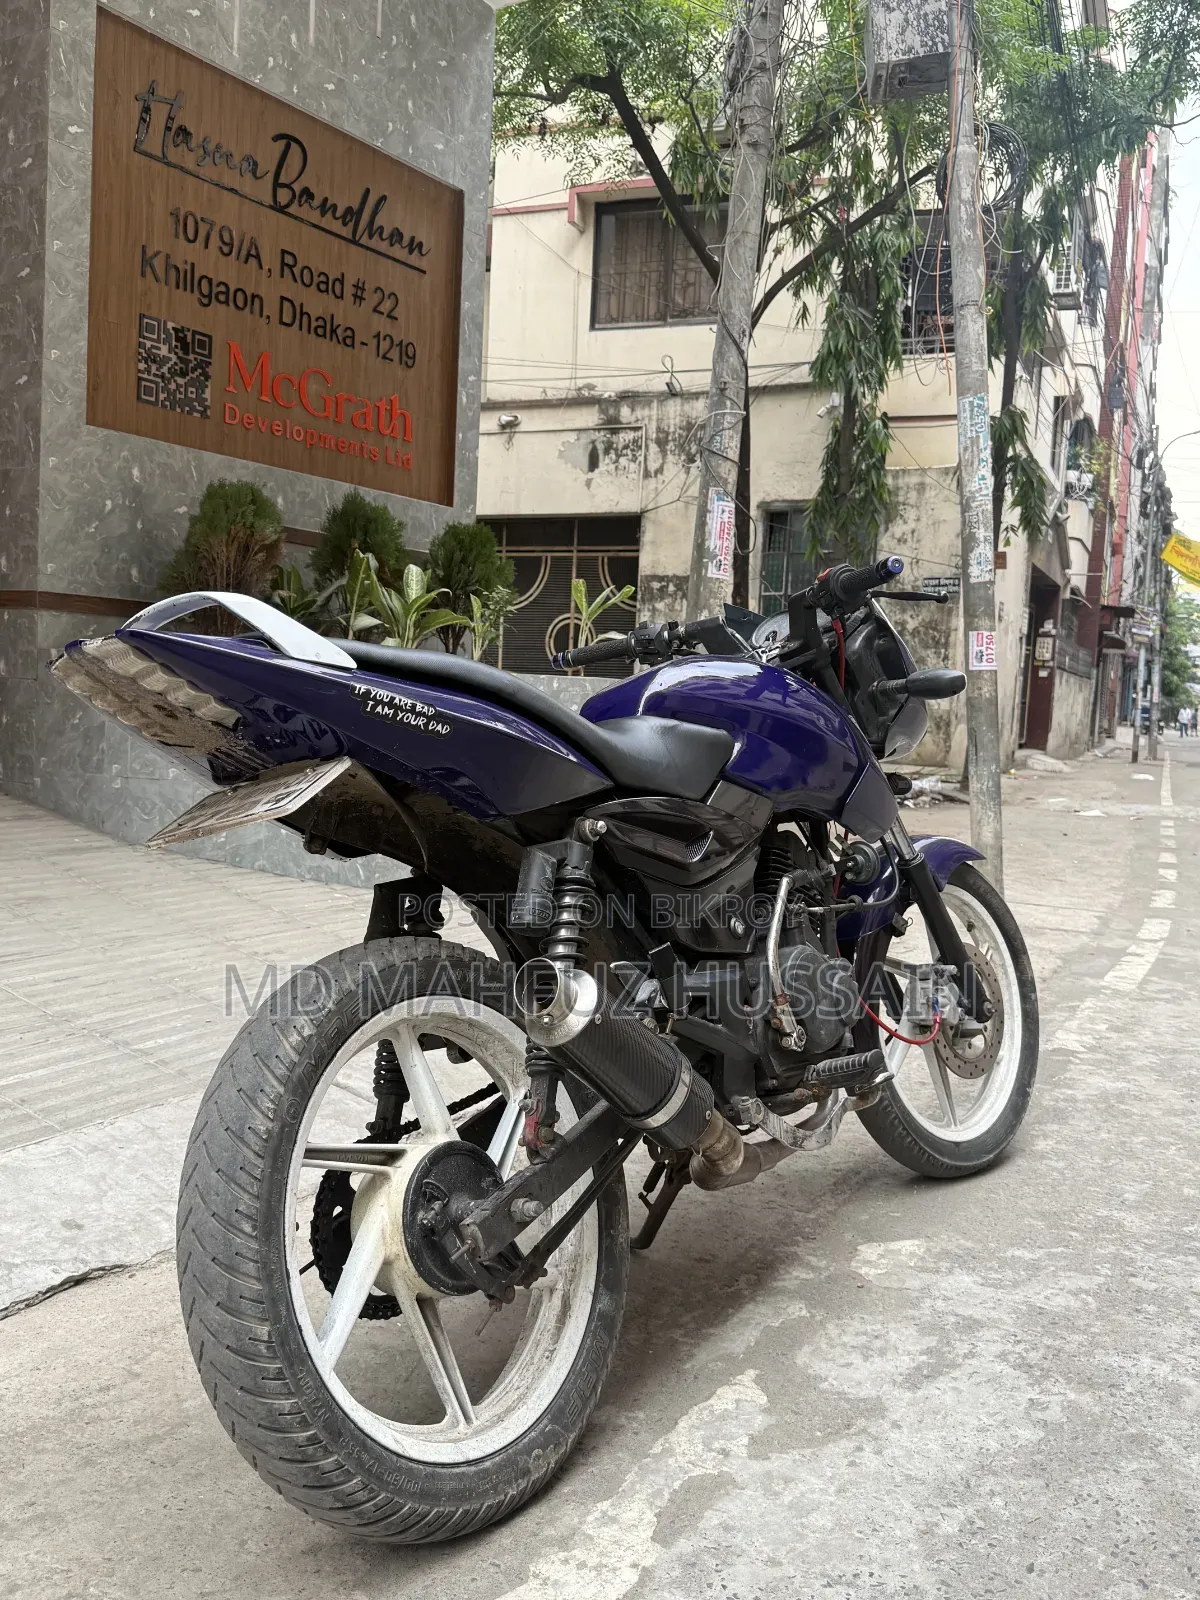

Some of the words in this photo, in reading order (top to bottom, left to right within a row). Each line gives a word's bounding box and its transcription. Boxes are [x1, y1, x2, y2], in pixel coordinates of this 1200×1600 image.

[271, 132, 432, 257] Bandhan
[141, 244, 271, 324] Khilgaon,
[280, 248, 345, 301] Road
[372, 286, 399, 321] 22
[225, 340, 413, 443] McGrath
[224, 402, 380, 462] Developments
[386, 446, 413, 469] Ltd
[985, 634, 995, 663] 01750
[354, 684, 368, 695] IF
[370, 688, 392, 702] YOU
[393, 696, 413, 710] ARE
[415, 703, 436, 716] BAD
[365, 700, 375, 712] I
[374, 704, 395, 718] AM
[396, 710, 427, 730] YOUR
[428, 720, 450, 735] DAD
